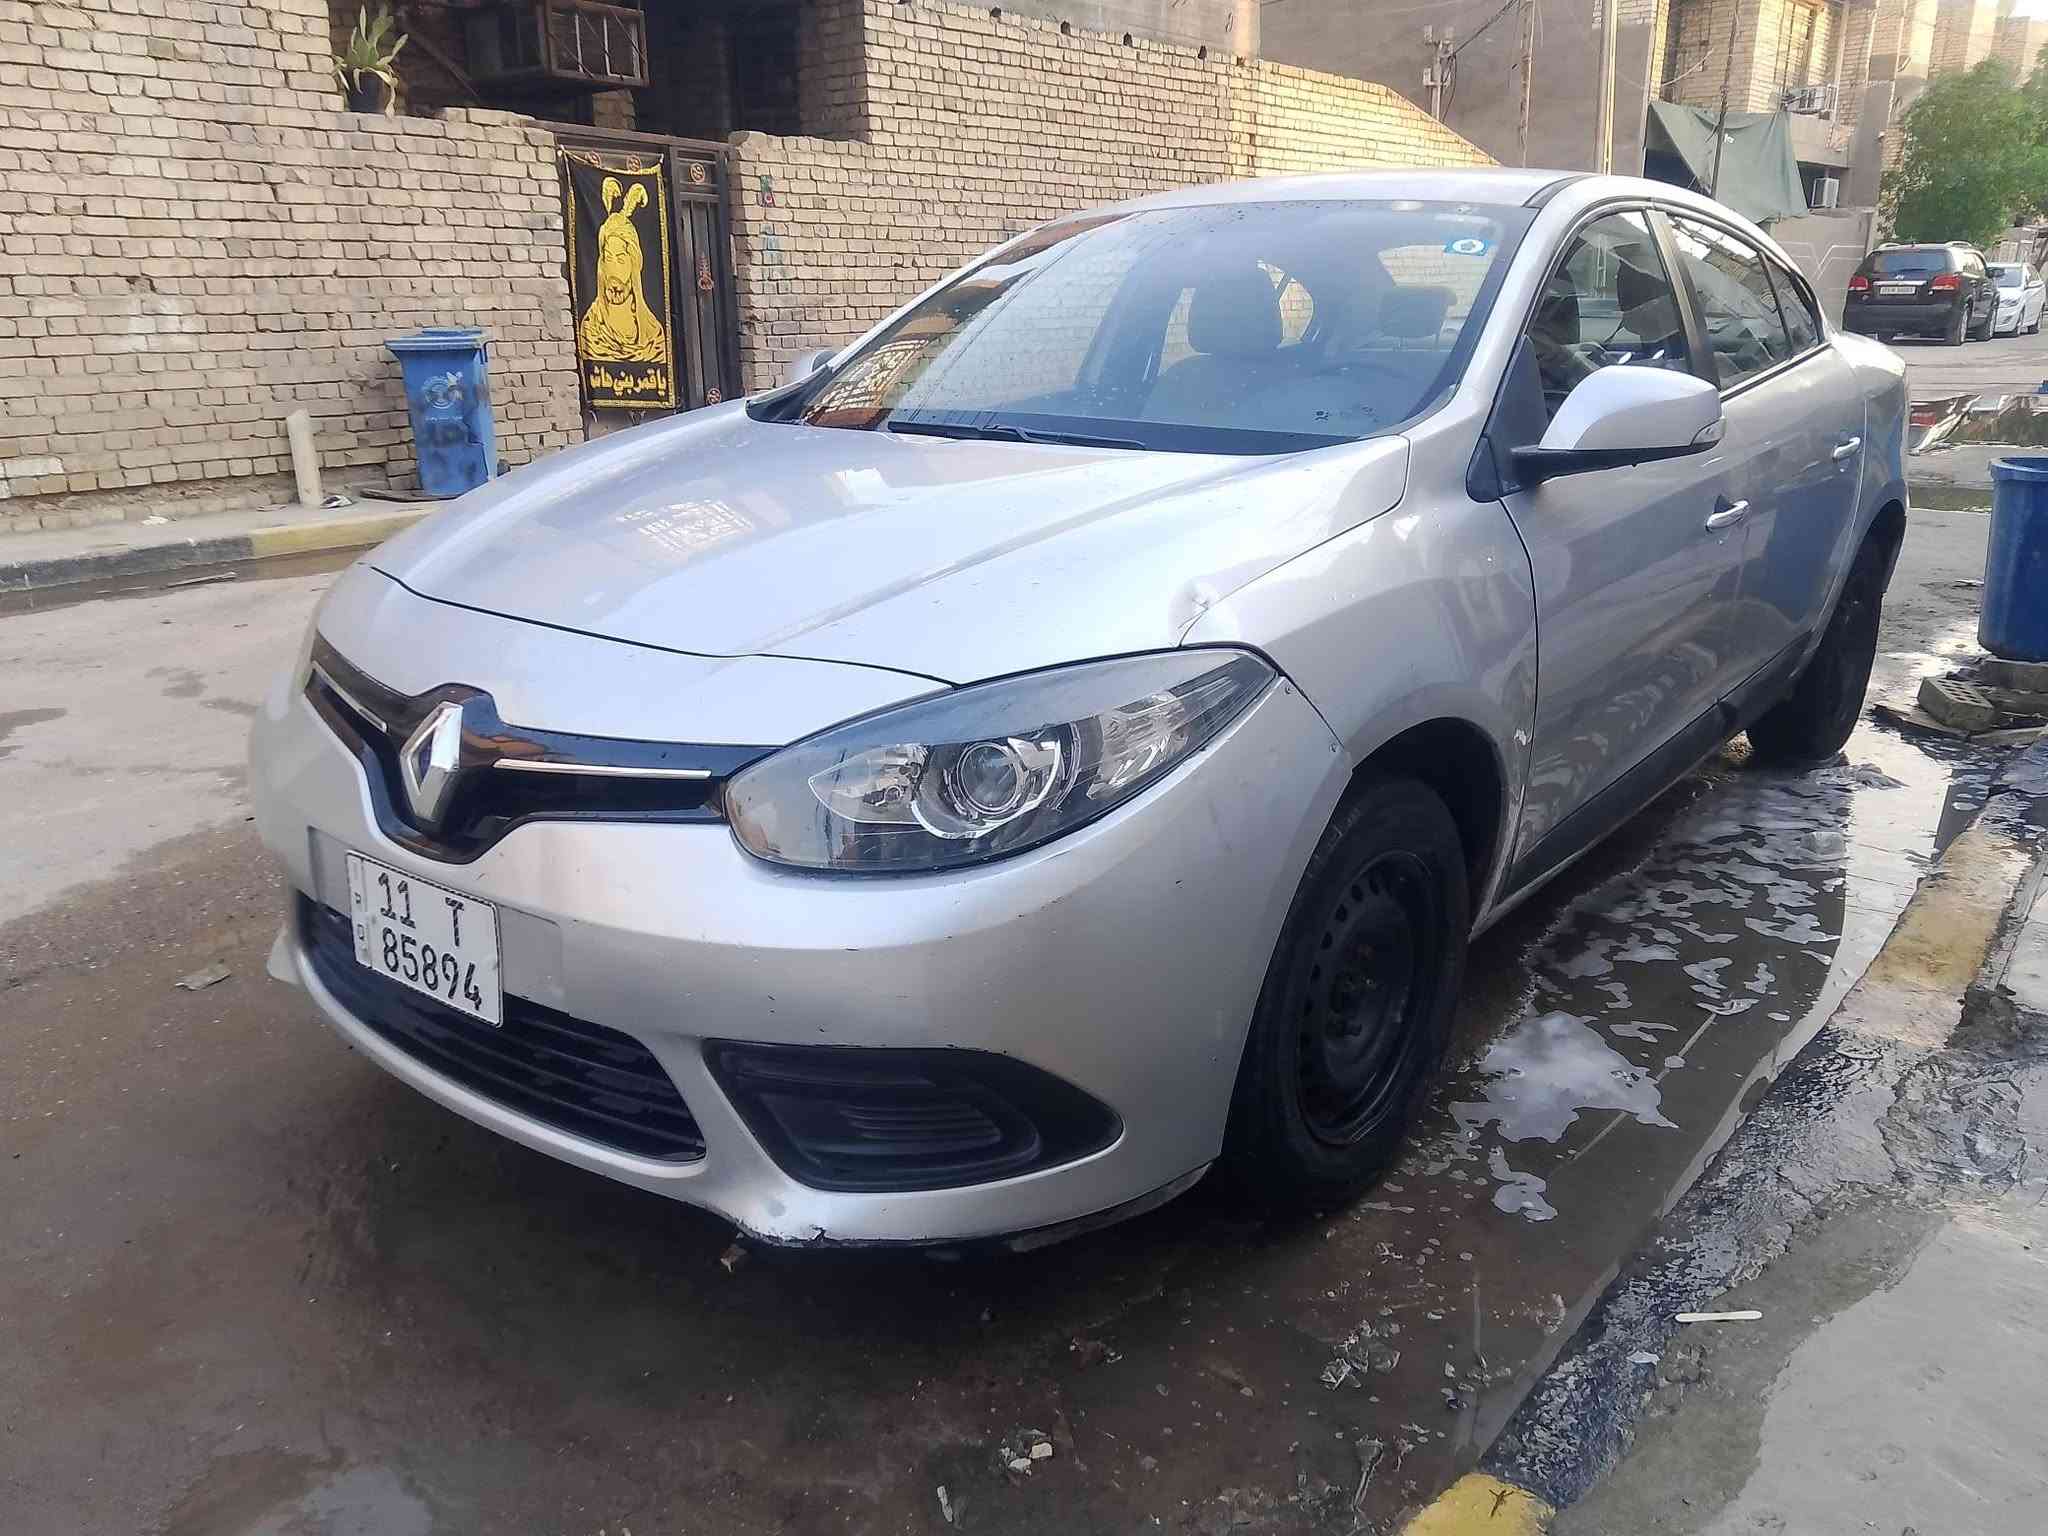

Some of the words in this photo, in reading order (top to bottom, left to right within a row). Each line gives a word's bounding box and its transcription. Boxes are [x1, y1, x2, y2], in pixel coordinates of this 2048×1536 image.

[589, 365, 613, 389] هاش
[612, 370, 634, 397] بني
[633, 367, 657, 393] قمر
[656, 366, 667, 397] يا
[378, 872, 416, 929] 11
[445, 897, 465, 947] T
[382, 927, 482, 1011] 85894
